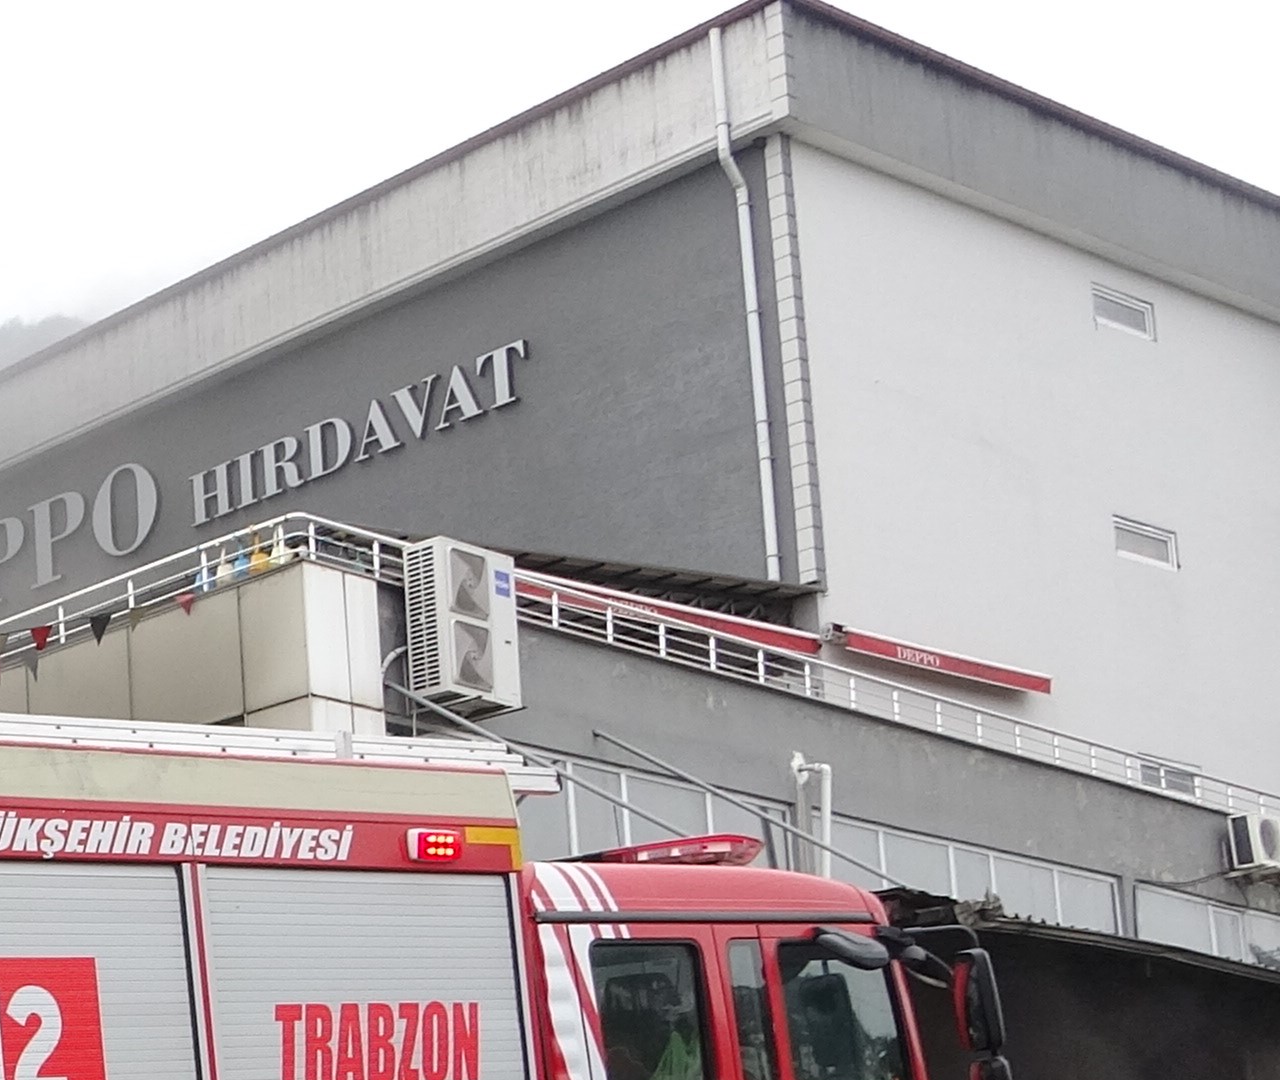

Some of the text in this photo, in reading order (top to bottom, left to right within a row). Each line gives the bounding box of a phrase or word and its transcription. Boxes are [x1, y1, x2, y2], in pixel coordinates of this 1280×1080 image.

[188, 339, 528, 527] HIRDAVAT
[896, 646, 940, 667] DEPPO
[158, 821, 354, 862] BELEDİYESİ
